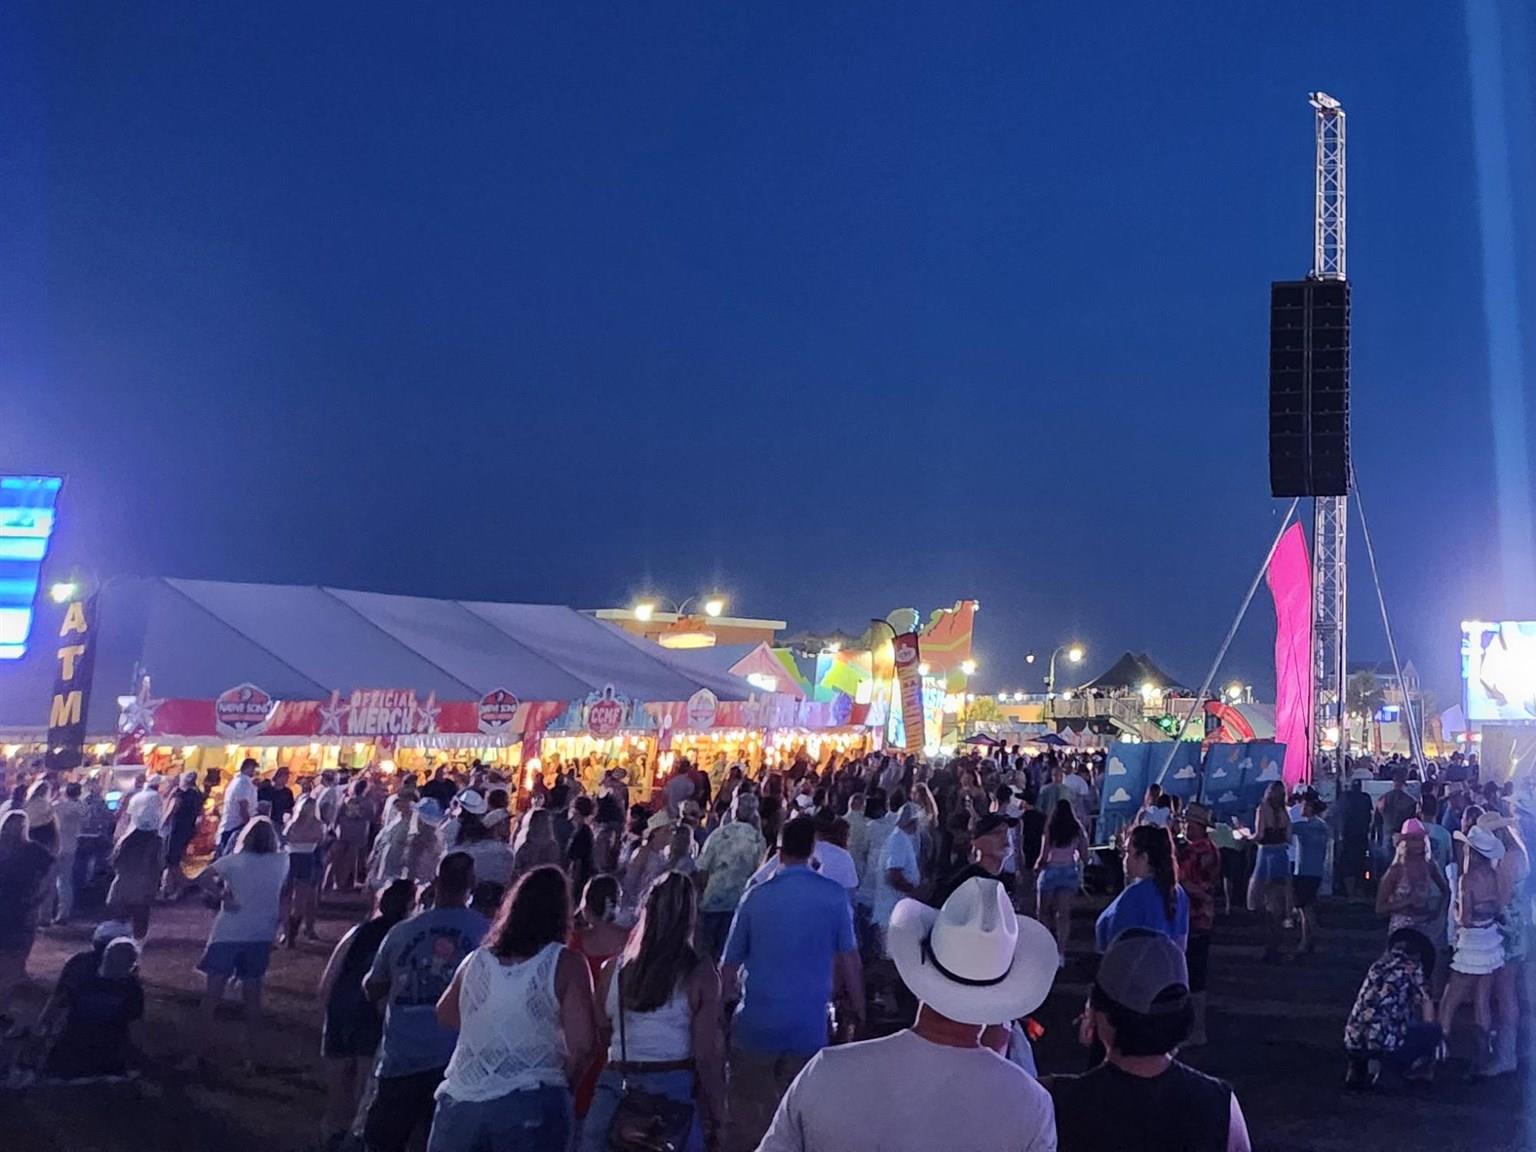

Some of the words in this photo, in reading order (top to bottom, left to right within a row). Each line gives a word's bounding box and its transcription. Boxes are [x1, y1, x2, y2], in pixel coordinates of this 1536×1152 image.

[50, 602, 88, 728] ATM
[350, 689, 417, 707] OFFICIAL
[348, 707, 415, 734] MERCH
